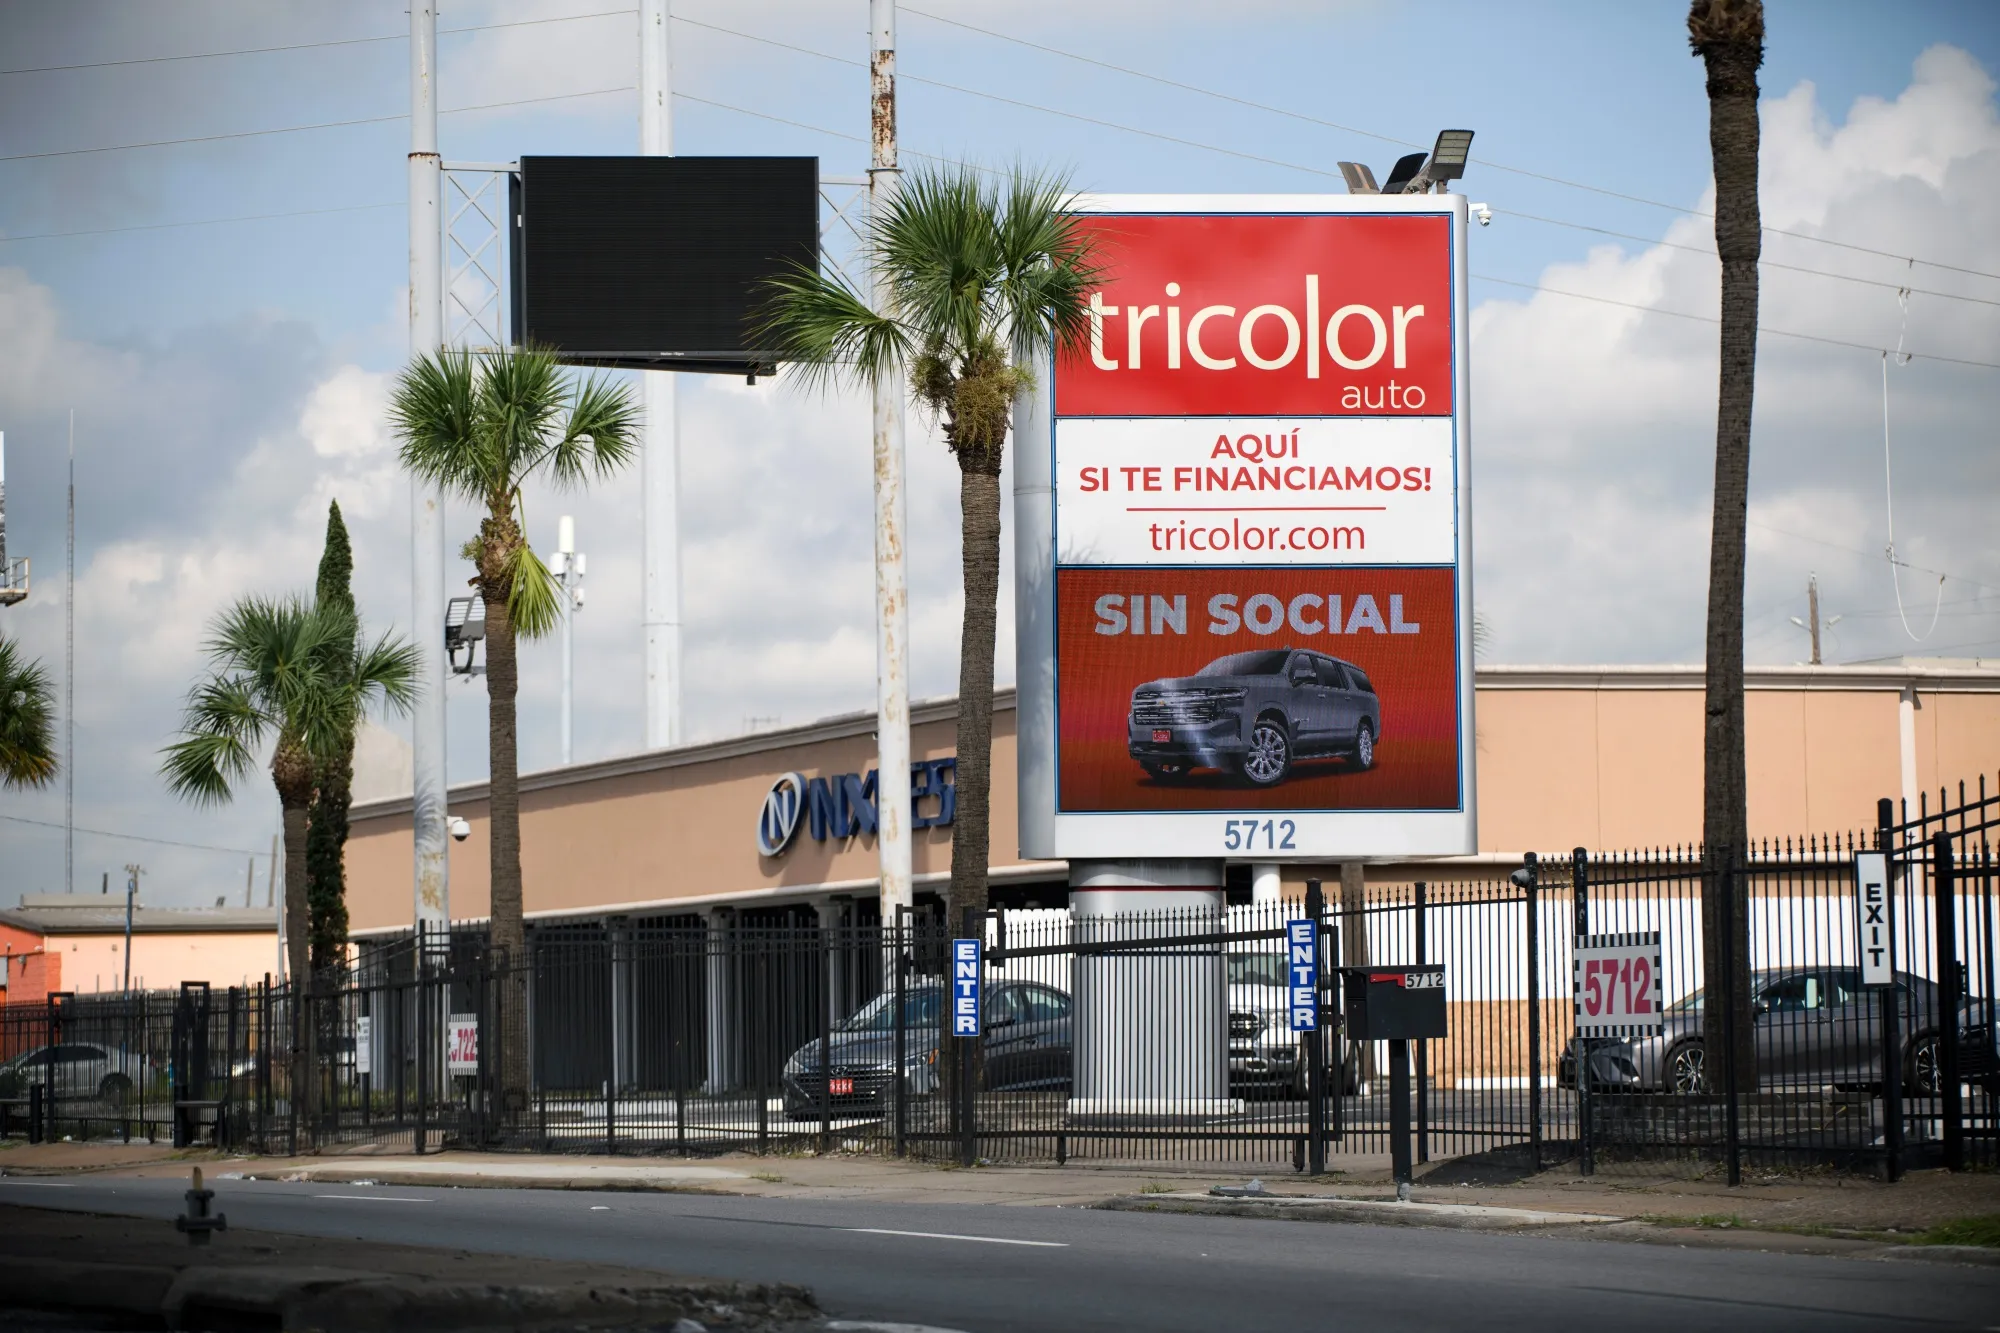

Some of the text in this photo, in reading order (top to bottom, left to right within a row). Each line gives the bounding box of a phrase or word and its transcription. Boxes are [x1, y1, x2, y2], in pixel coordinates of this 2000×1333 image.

[1081, 274, 1425, 379] tricolor
[1341, 380, 1426, 409] auto
[1210, 428, 1301, 464] AQUÍ
[1079, 465, 1432, 492] SI TE FINANCIAMOS!
[1149, 517, 1365, 551] tricolor.com
[1094, 593, 1420, 636] SIN SOCIAL
[1224, 819, 1297, 850] 5712
[1865, 882, 1885, 967] EXIT
[956, 943, 977, 1033] ENTER
[1291, 924, 1315, 1027] ENTER
[1406, 972, 1444, 988] 5712
[1584, 956, 1652, 1017] 5712
